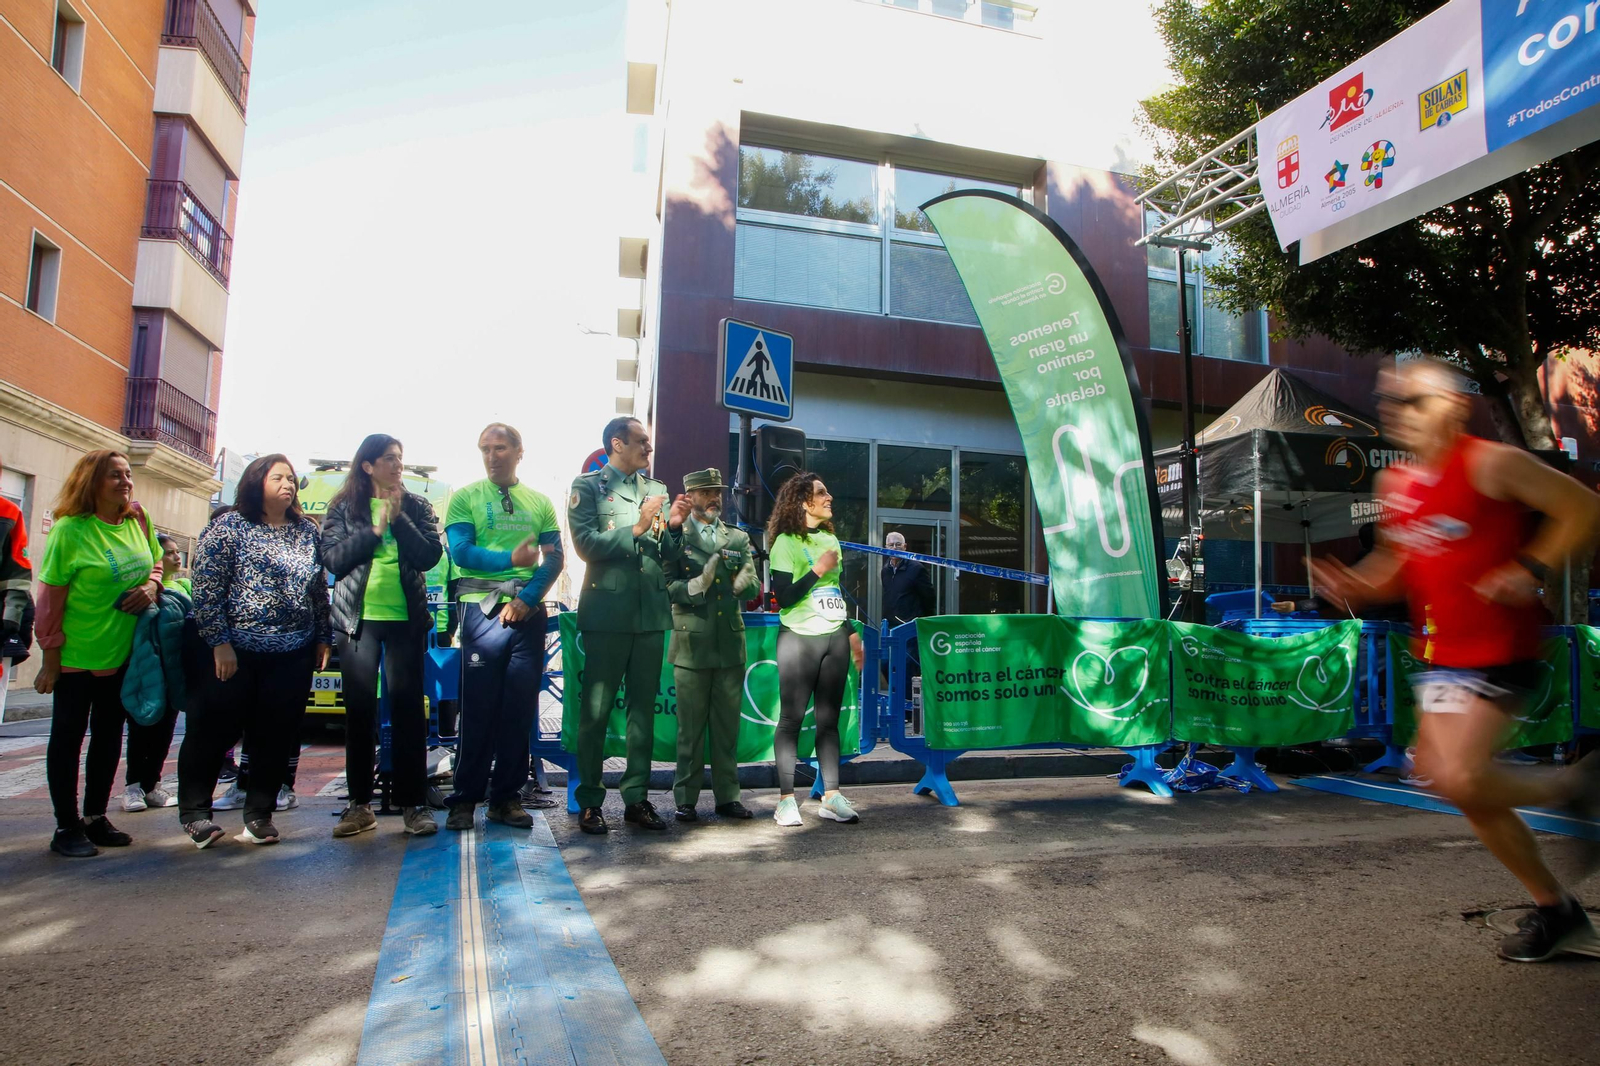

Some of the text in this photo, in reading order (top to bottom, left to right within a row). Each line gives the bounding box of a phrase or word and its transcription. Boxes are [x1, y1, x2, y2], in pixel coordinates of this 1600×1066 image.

[1270, 185, 1311, 213] ALMERÍA
[1279, 202, 1302, 219] CIUDAD
[954, 639, 982, 648] española
[935, 669, 992, 685] Contra
[996, 666, 1012, 682] el
[1233, 677, 1246, 690] el
[1247, 678, 1292, 691] cáncer
[936, 683, 1057, 703] somos solo un
[1230, 692, 1260, 707] solo
[1261, 696, 1287, 707] uno
